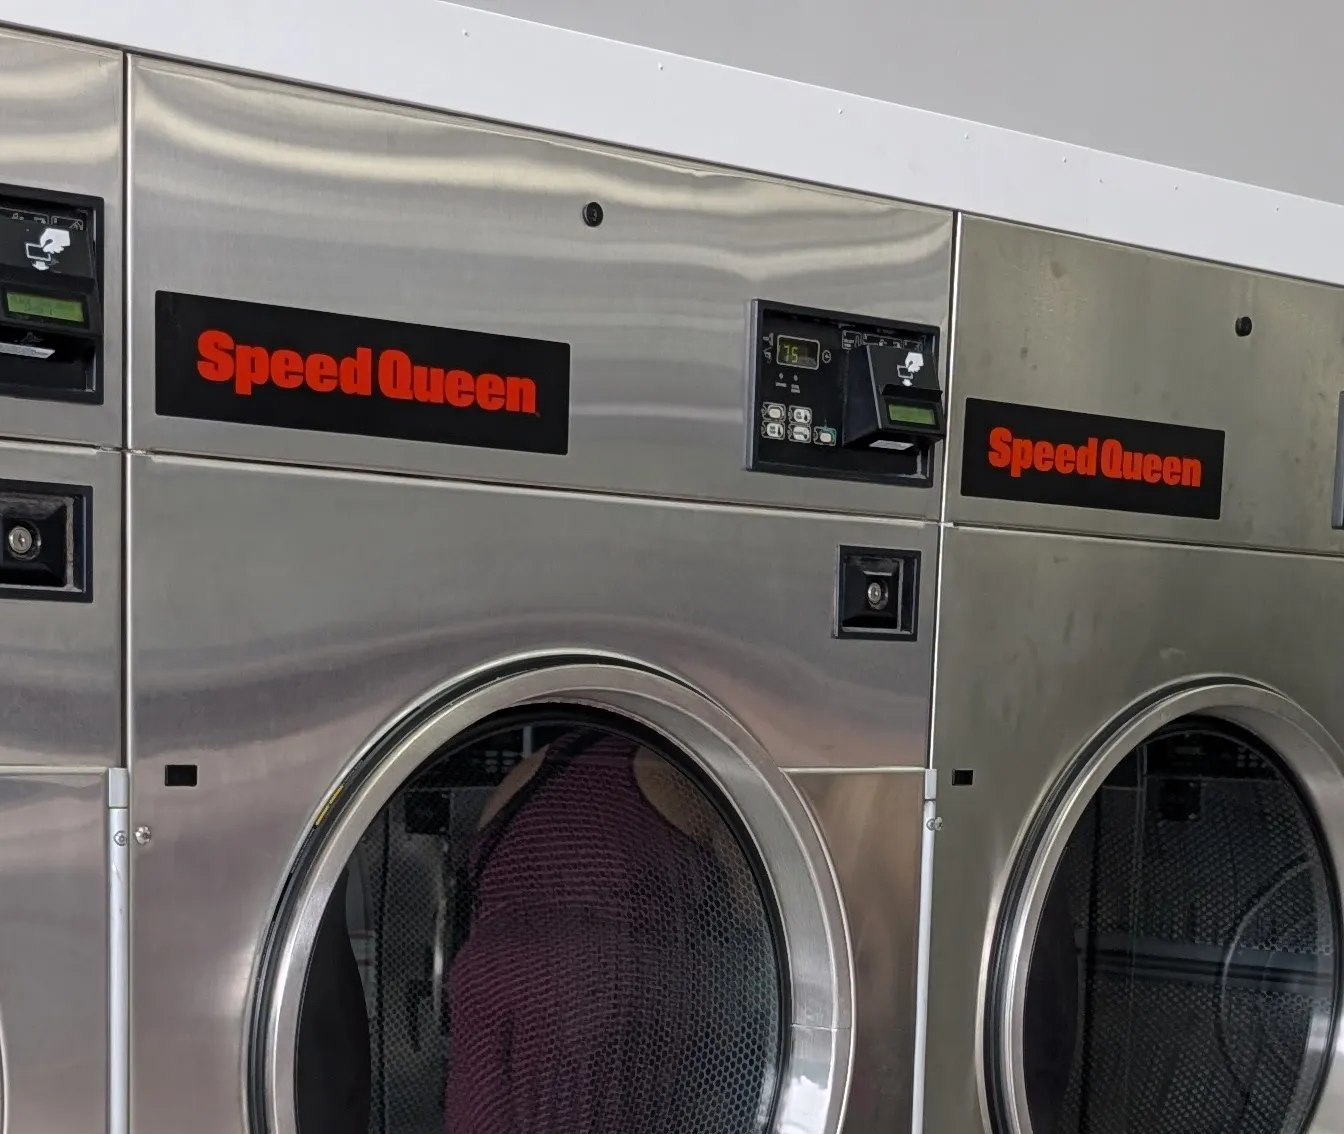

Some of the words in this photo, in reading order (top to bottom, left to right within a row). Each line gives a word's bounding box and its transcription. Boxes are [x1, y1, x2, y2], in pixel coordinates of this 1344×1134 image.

[196, 329, 373, 396] Speed
[377, 349, 537, 414] Queen
[988, 426, 1098, 478] Speed
[1100, 439, 1202, 488] Queen
